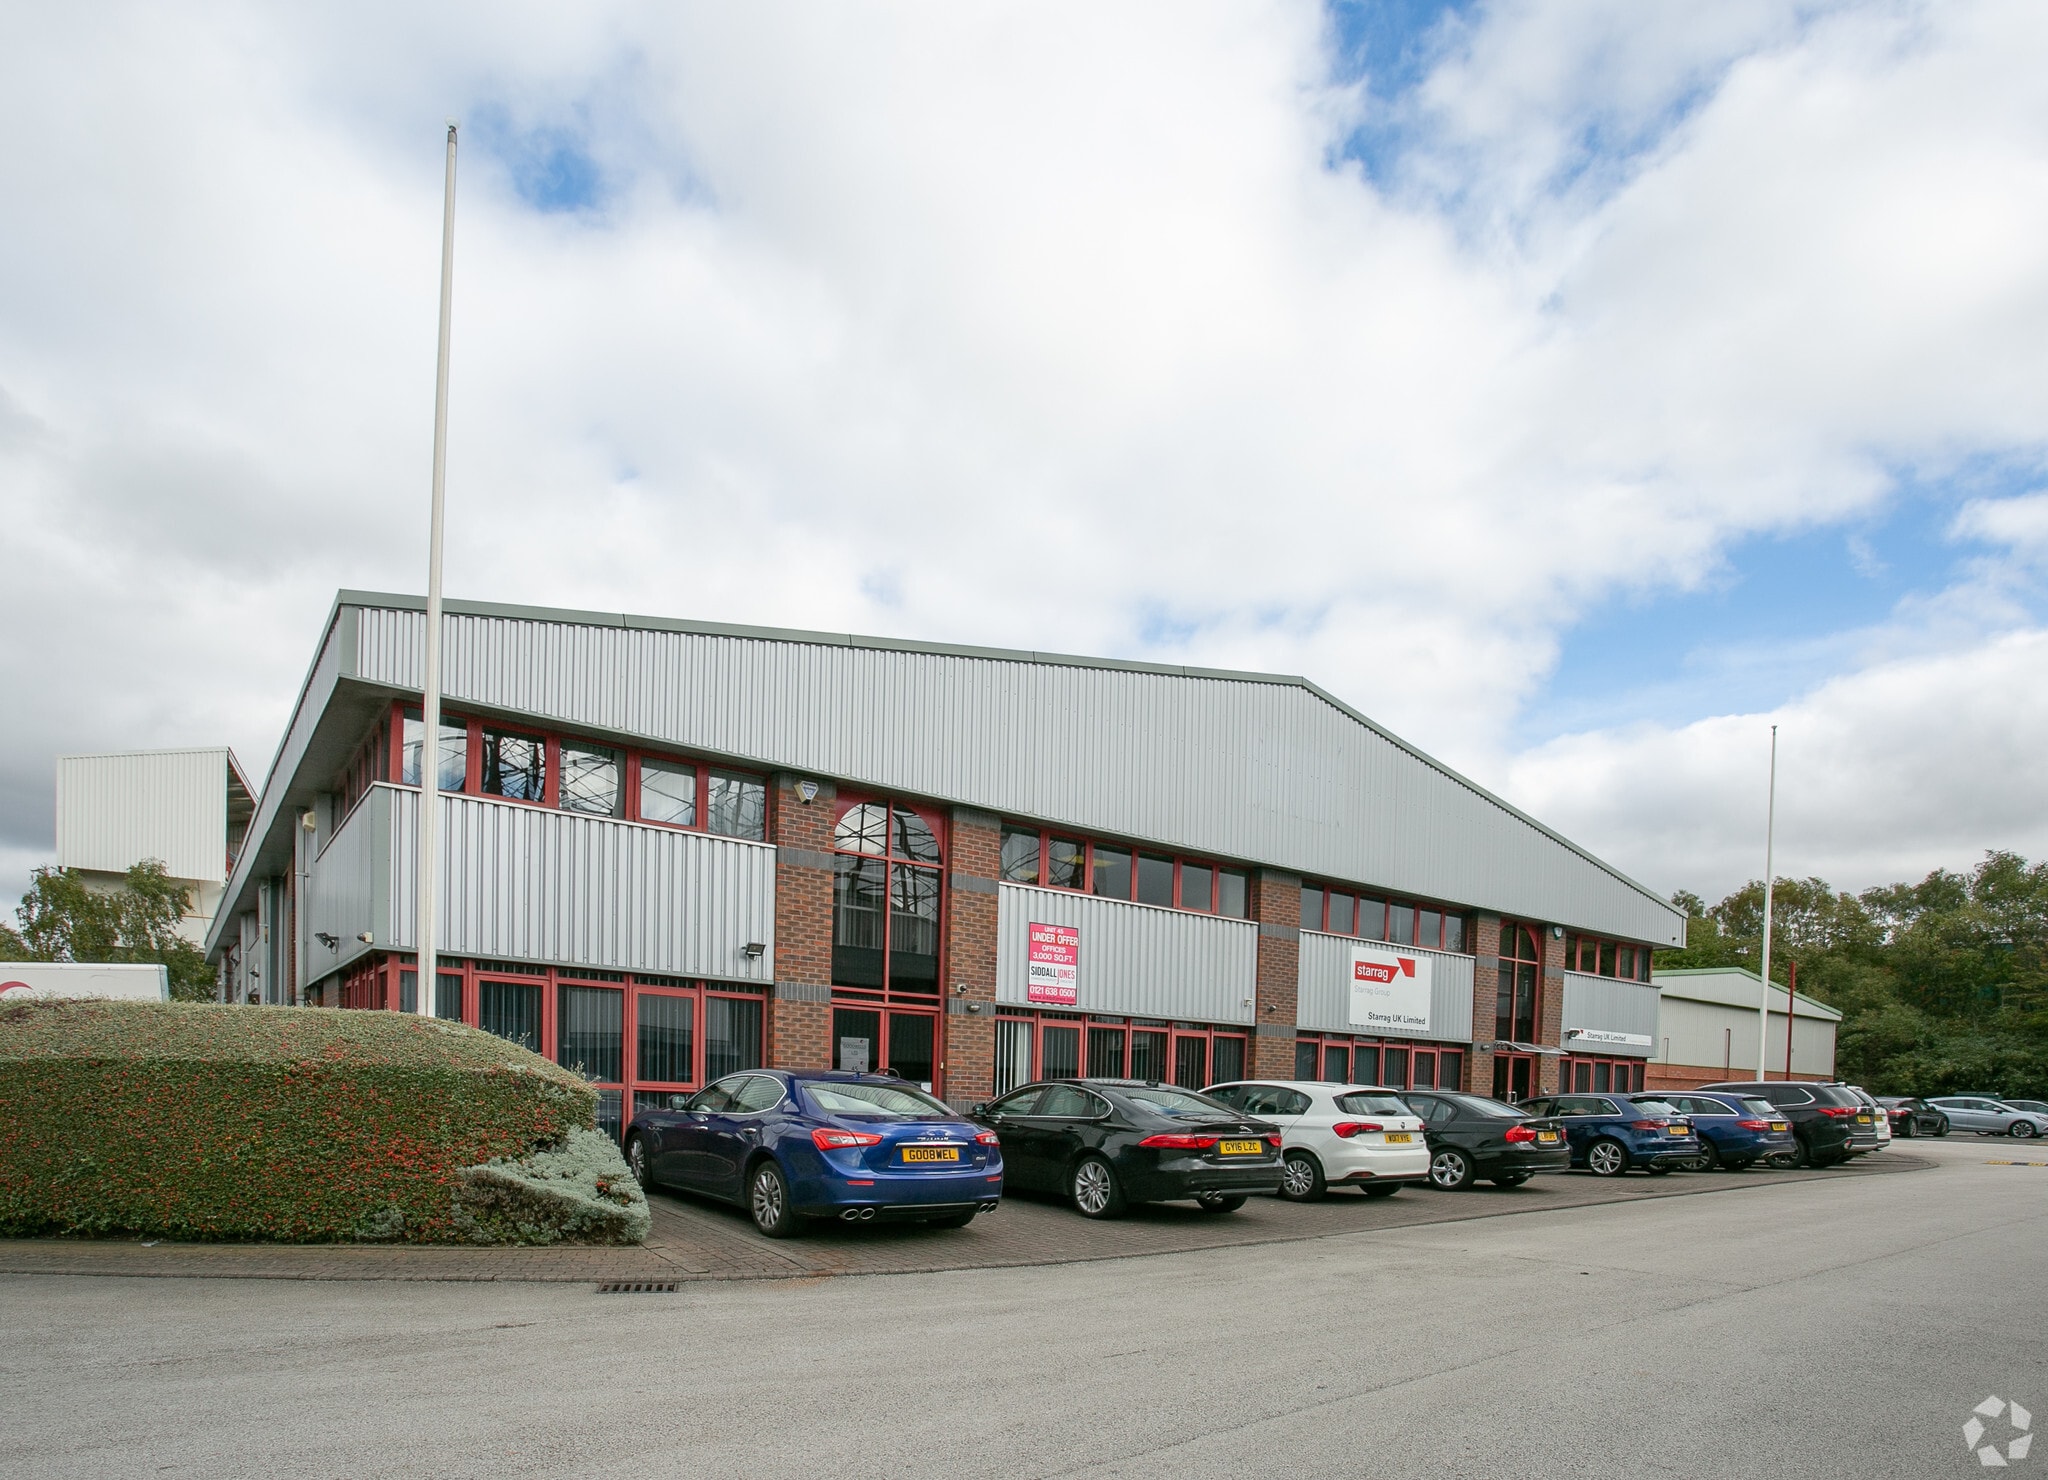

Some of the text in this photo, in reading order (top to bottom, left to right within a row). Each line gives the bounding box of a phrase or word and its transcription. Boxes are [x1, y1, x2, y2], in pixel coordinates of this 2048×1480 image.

[1032, 931, 1078, 946] UNDER OFFER
[1042, 945, 1066, 953] OFFICES
[1031, 966, 1057, 978] SIDDALL
[1357, 965, 1389, 981] starrag
[1029, 986, 1075, 997] 0121 638 0500
[1354, 985, 1391, 997] Starrag Group
[1368, 1011, 1426, 1025] Starrag UK Limited
[1225, 1142, 1257, 1151] GY16 LZC
